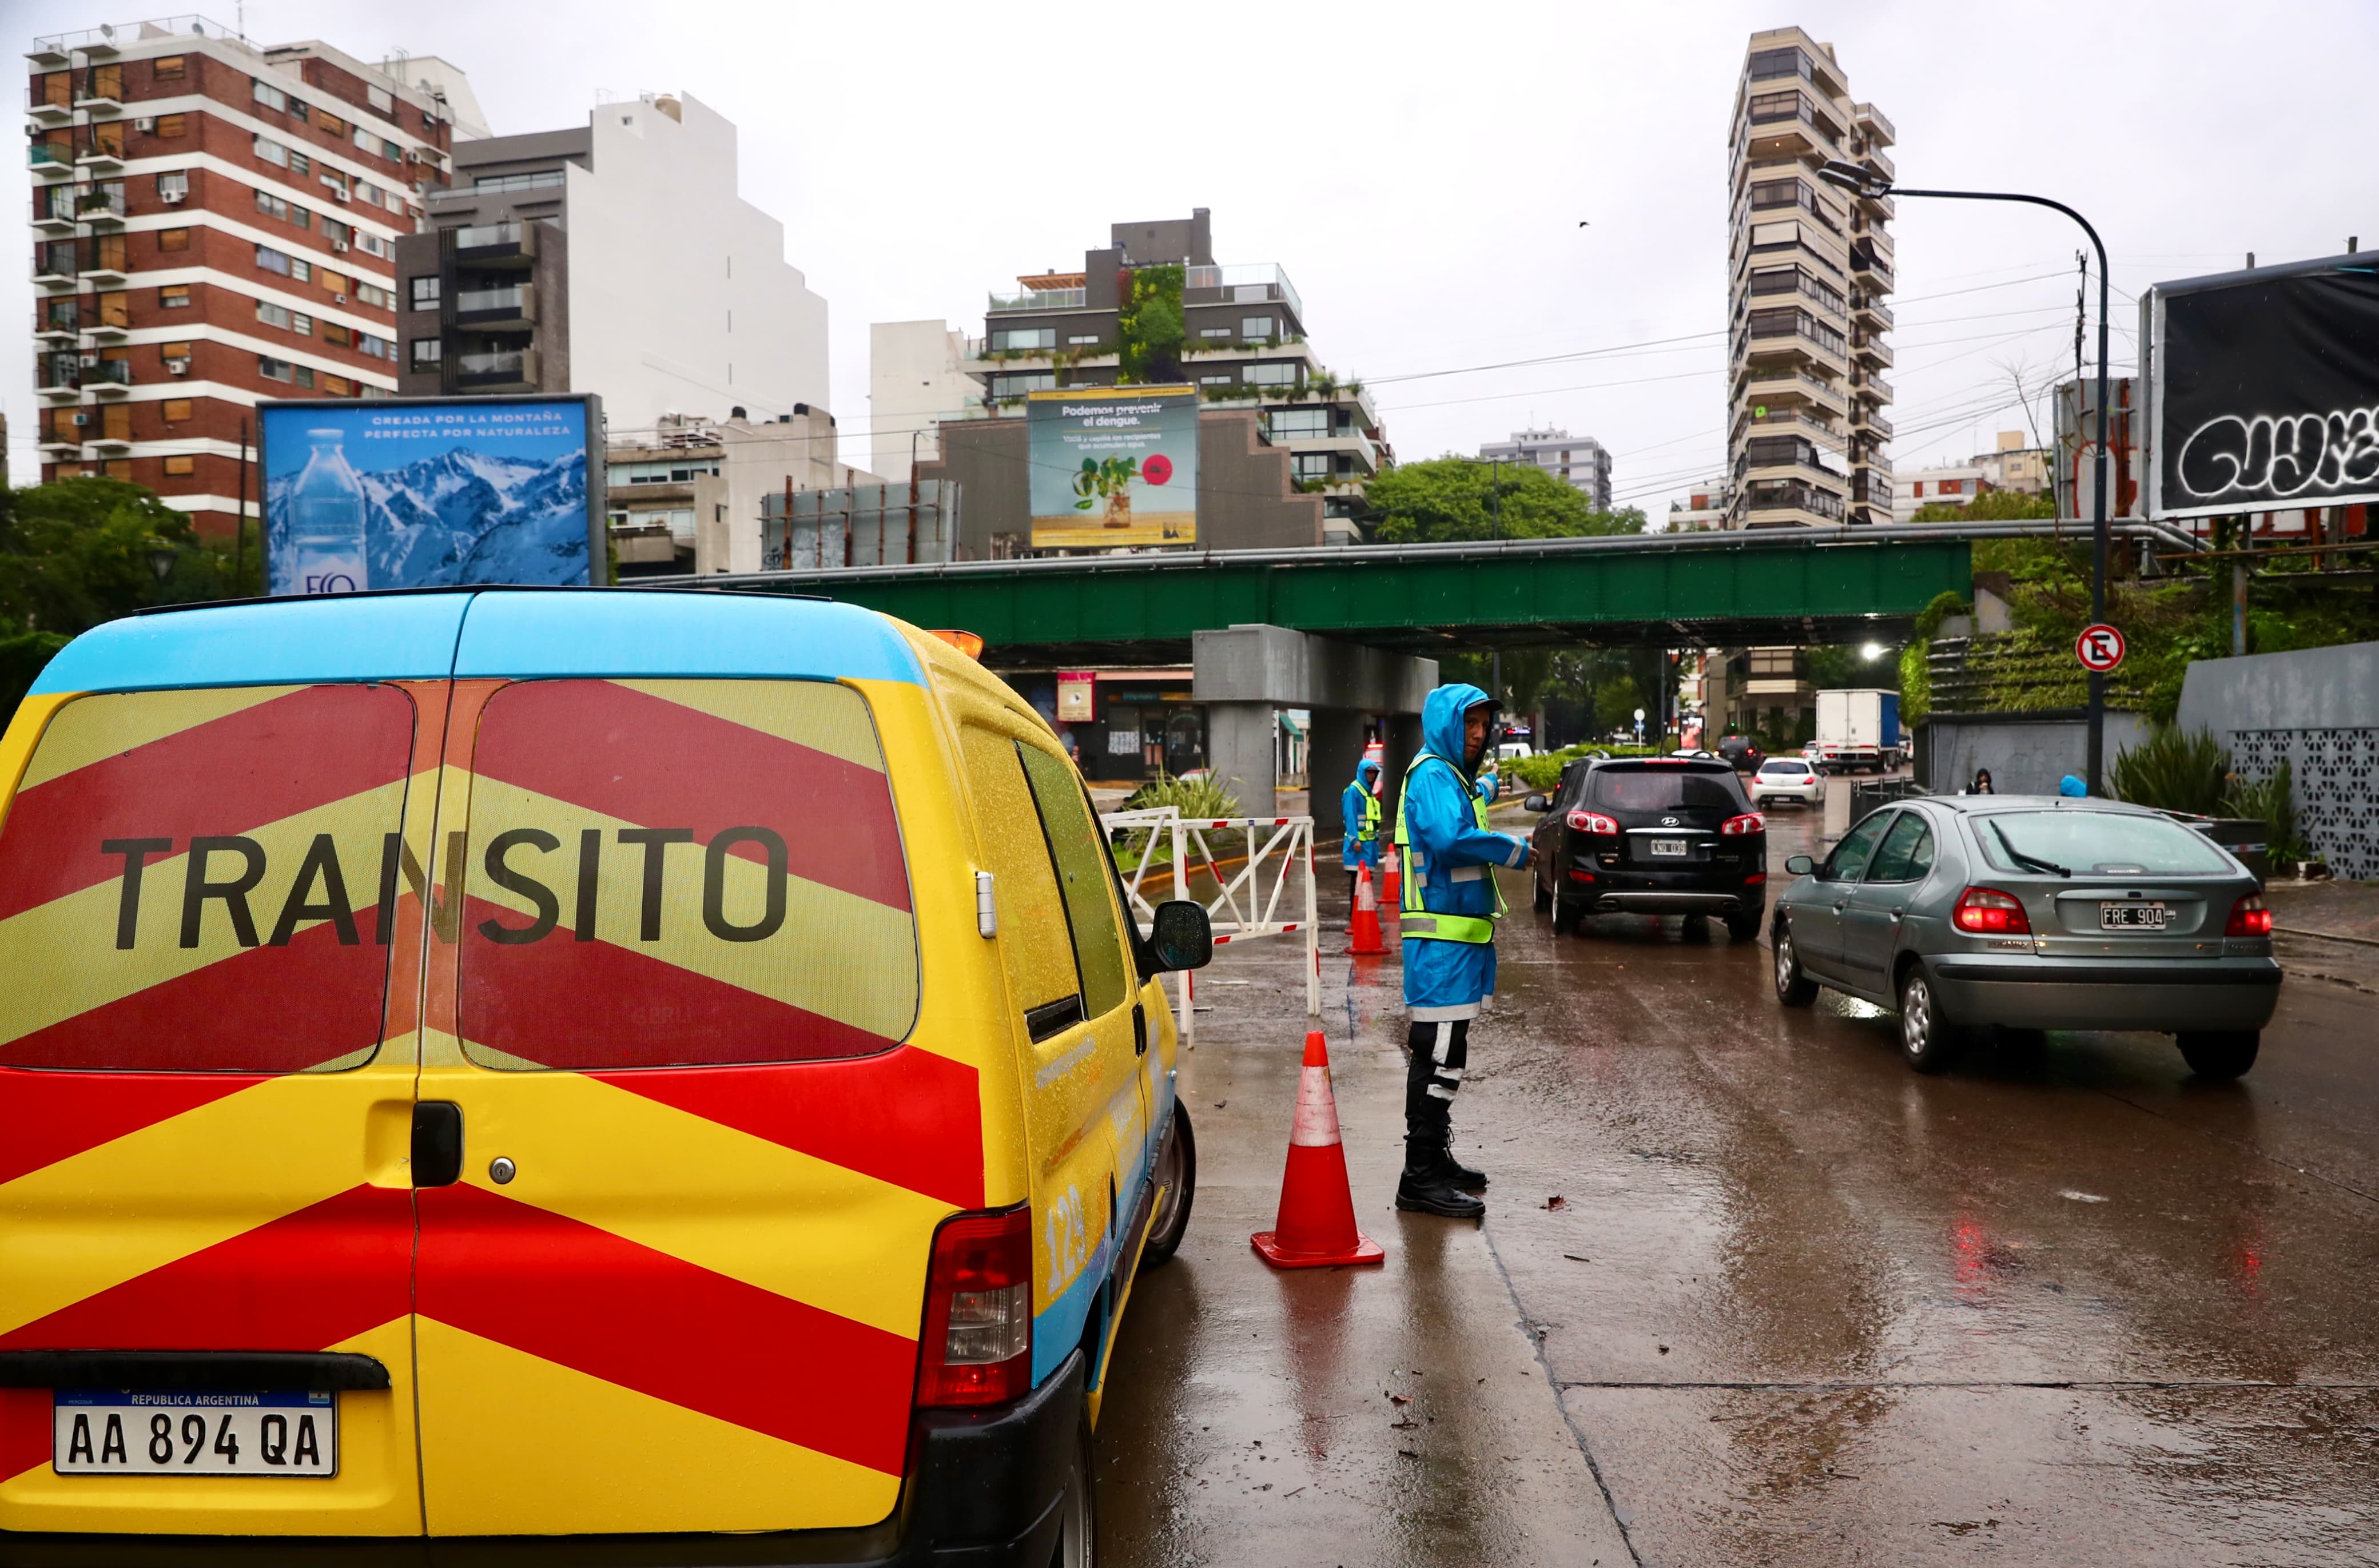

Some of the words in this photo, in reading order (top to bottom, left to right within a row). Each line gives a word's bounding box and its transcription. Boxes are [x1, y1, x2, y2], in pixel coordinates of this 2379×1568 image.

[1062, 405, 1114, 416] Podemos
[1116, 403, 1162, 416] prevenir
[372, 416, 430, 425] CREADA
[435, 415, 464, 424] POR
[469, 415, 487, 423] LA
[491, 411, 562, 423] MONTAÑA
[1083, 417, 1093, 427] el
[1096, 416, 1141, 428] dengue.
[364, 429, 438, 439] PERFECTA
[443, 428, 472, 437] POR
[476, 426, 571, 437] NATURALEZA
[1671, 843, 1685, 853] 039
[100, 825, 789, 951] TRANSITO
[2103, 909, 2129, 925] FRE
[2137, 909, 2164, 925] 904
[131, 1395, 192, 1406] REPUBLICA
[195, 1395, 259, 1406] ARGENTINA
[68, 1413, 128, 1464] AA
[148, 1412, 240, 1464] 894
[260, 1414, 320, 1466] QA
